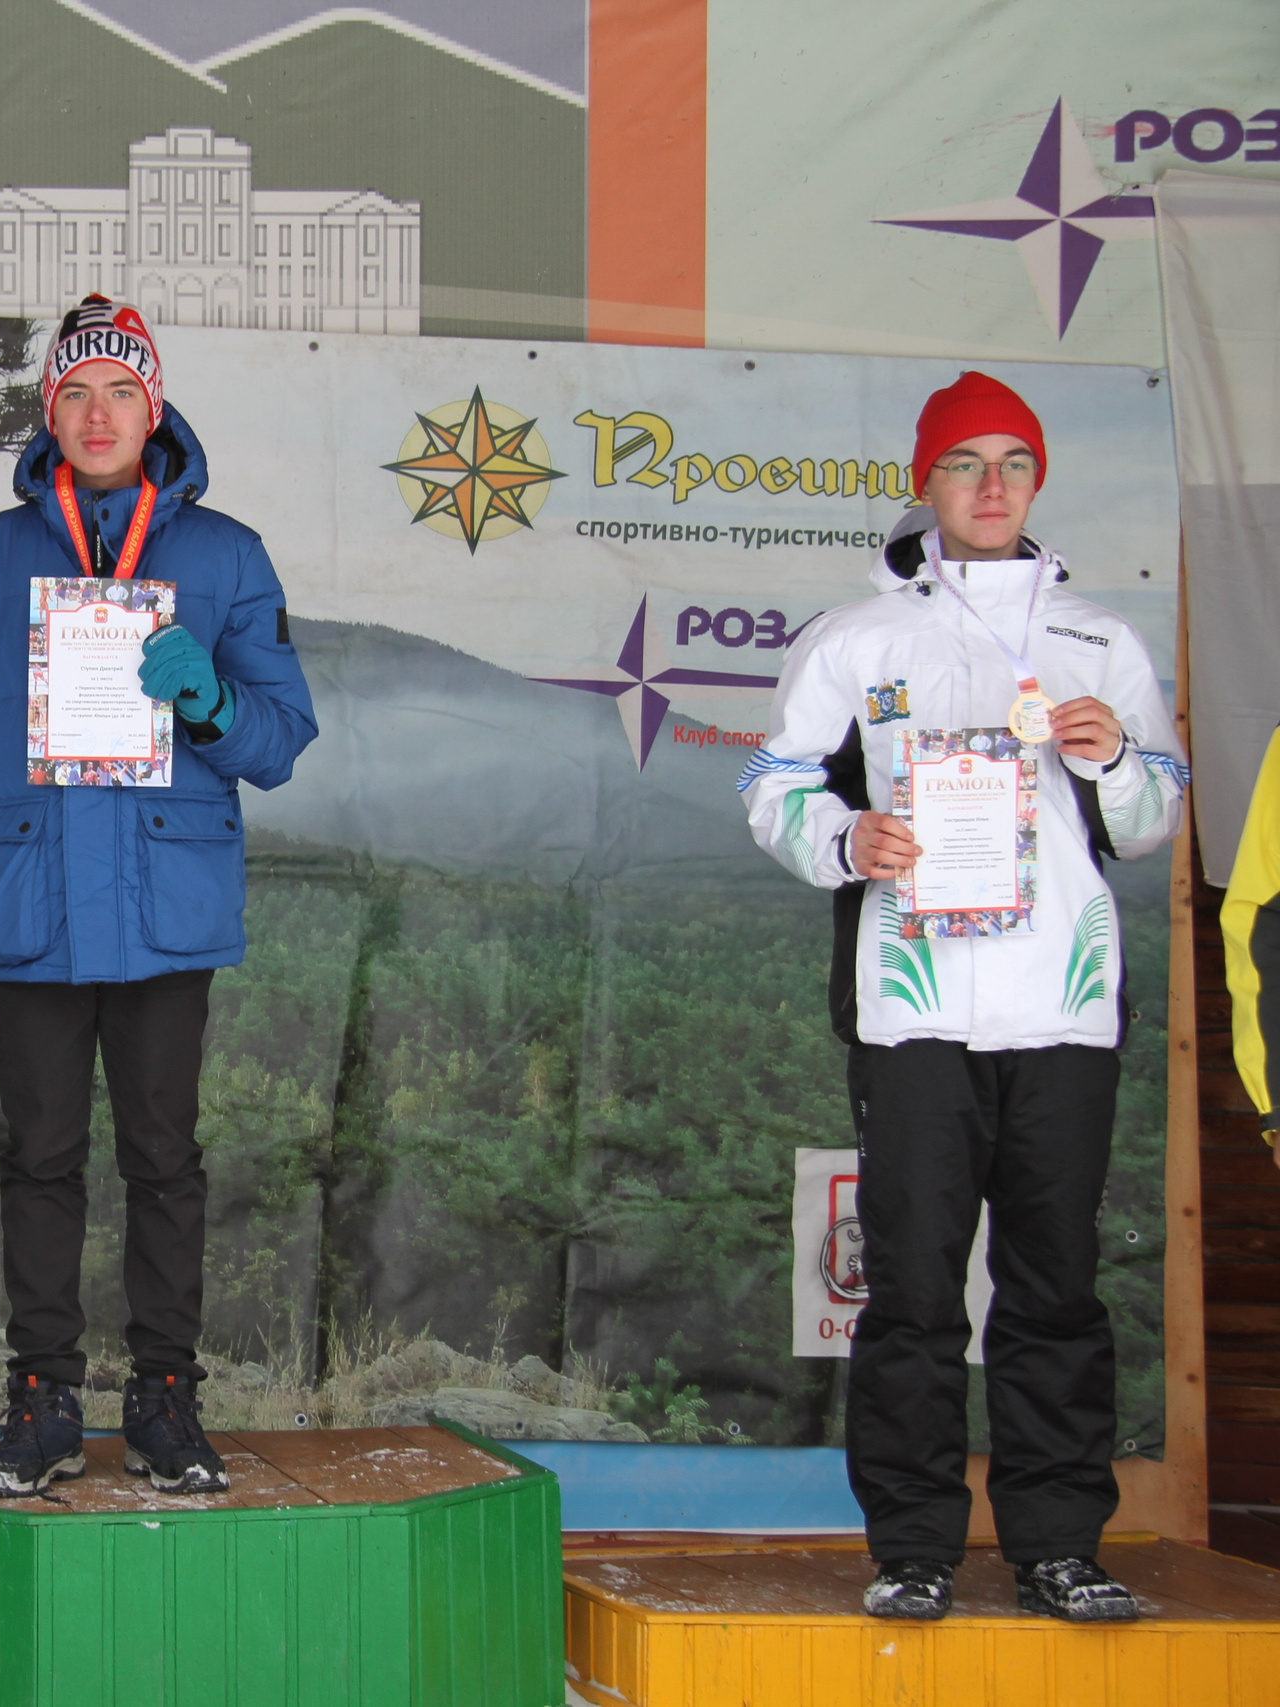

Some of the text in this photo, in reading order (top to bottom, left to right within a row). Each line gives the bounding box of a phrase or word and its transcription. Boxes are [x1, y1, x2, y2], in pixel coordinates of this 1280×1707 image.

[55, 329, 150, 376] EUROPE
[573, 409, 923, 509] Провинц
[122, 526, 141, 569] ОБЛАСТЬ
[60, 626, 141, 640] ГРАМОТА
[676, 605, 826, 650] РОЗ
[1047, 626, 1109, 648] PROTEAM
[673, 725, 766, 749] Клуб спор
[925, 777, 1006, 792] ГРАМОТА
